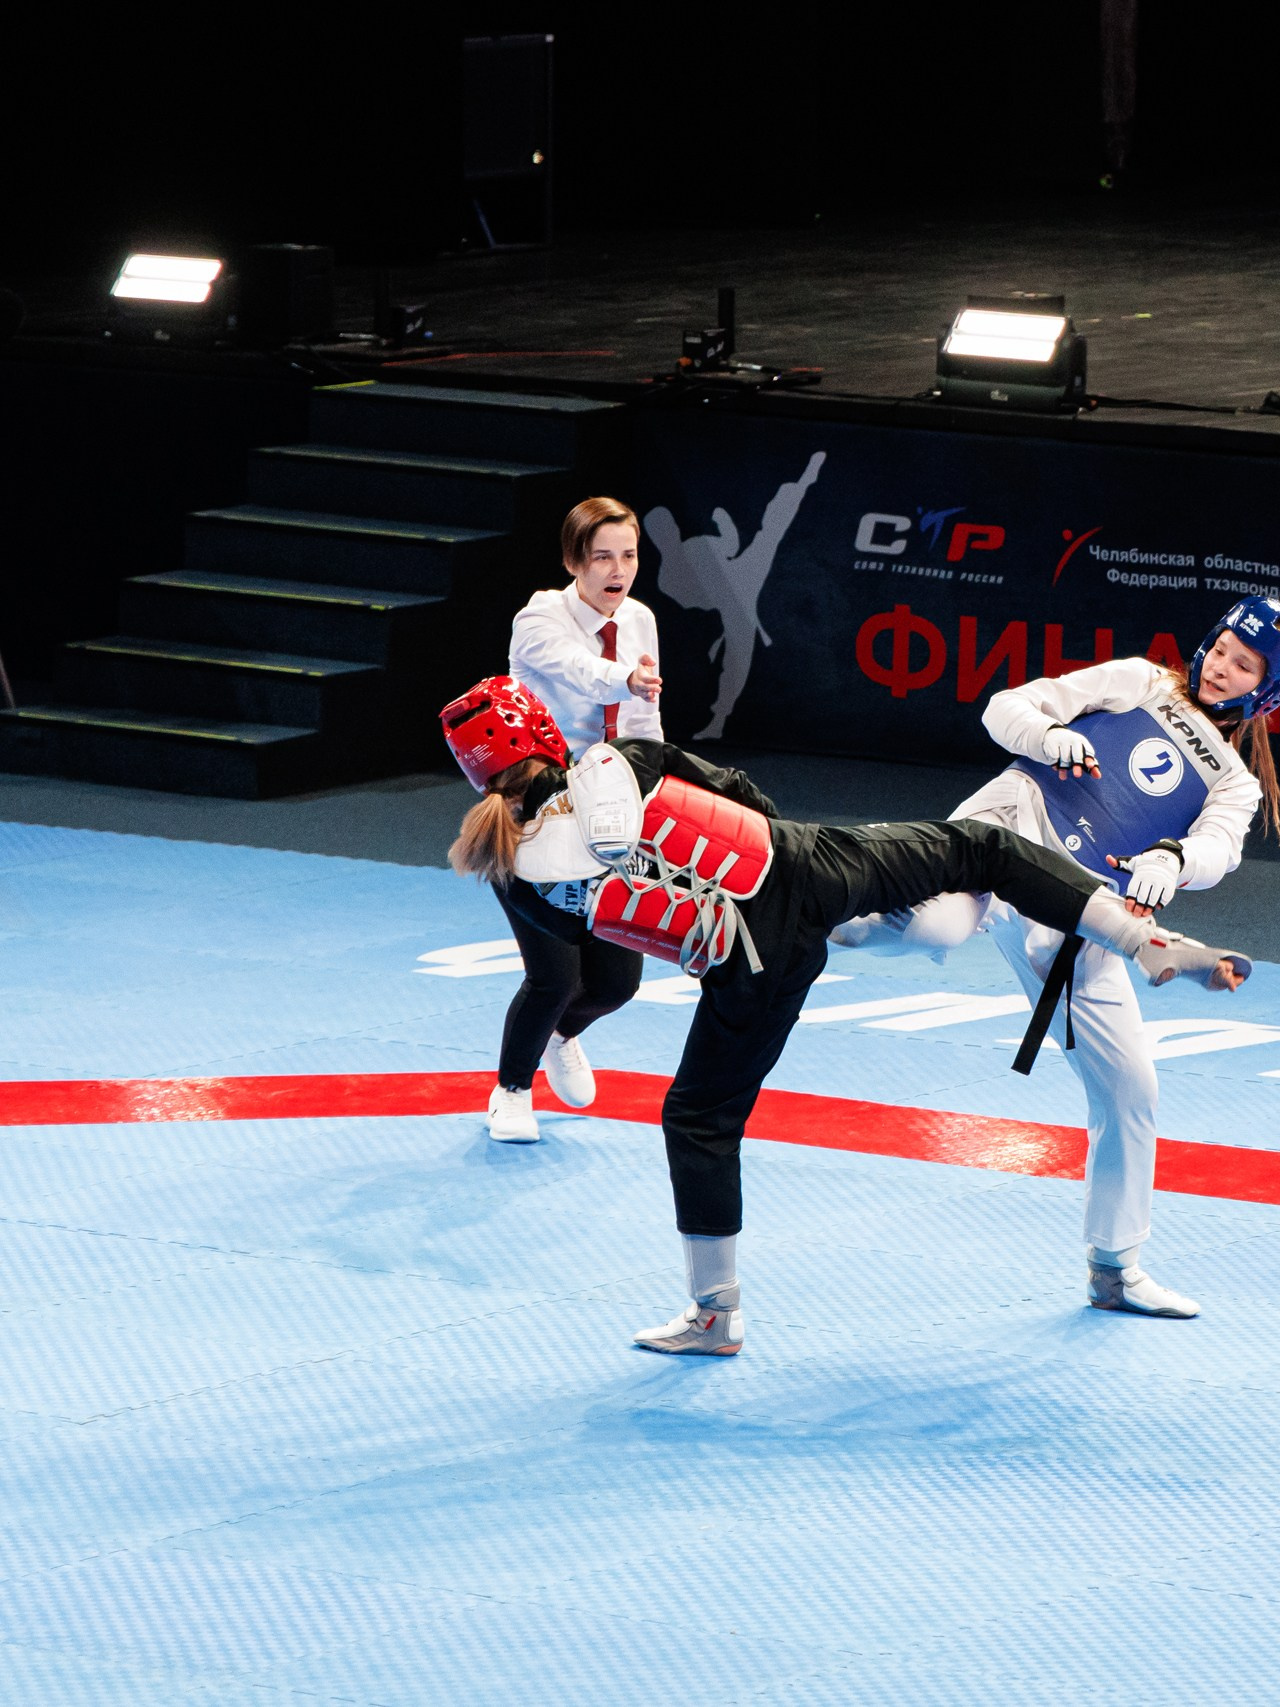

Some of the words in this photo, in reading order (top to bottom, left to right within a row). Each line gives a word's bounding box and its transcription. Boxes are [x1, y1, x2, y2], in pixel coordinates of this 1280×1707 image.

[1088, 544, 1195, 567] Челябинская
[959, 571, 1005, 585] РОССИИ
[1106, 568, 1197, 589] Федерация
[1157, 703, 1221, 772] KPNP
[1138, 750, 1174, 784] 2
[1068, 838, 1078, 848] 3
